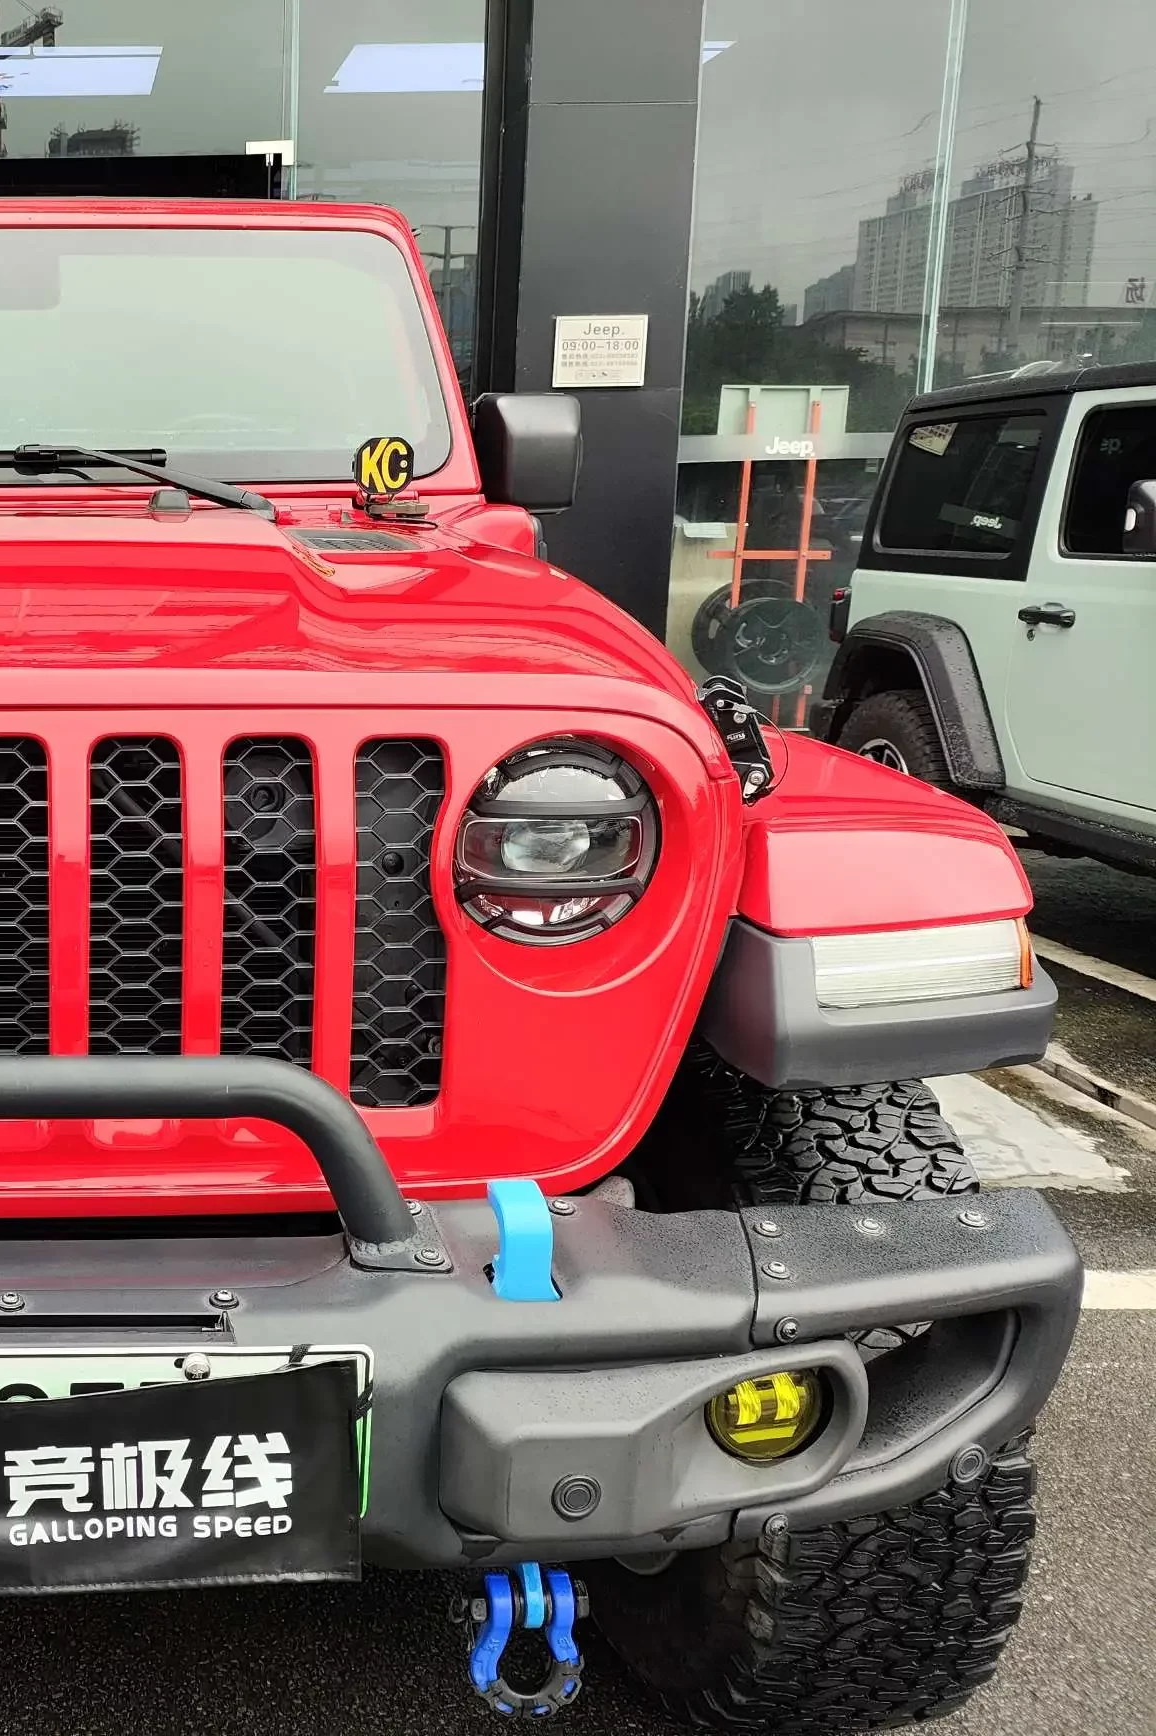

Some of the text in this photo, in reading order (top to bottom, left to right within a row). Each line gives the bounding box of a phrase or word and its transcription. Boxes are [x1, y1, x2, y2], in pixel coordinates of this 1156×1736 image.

[361, 438, 407, 493] KC
[4, 1432, 293, 1517] 竞极线
[9, 1514, 293, 1546] GALLOPING SPEED
